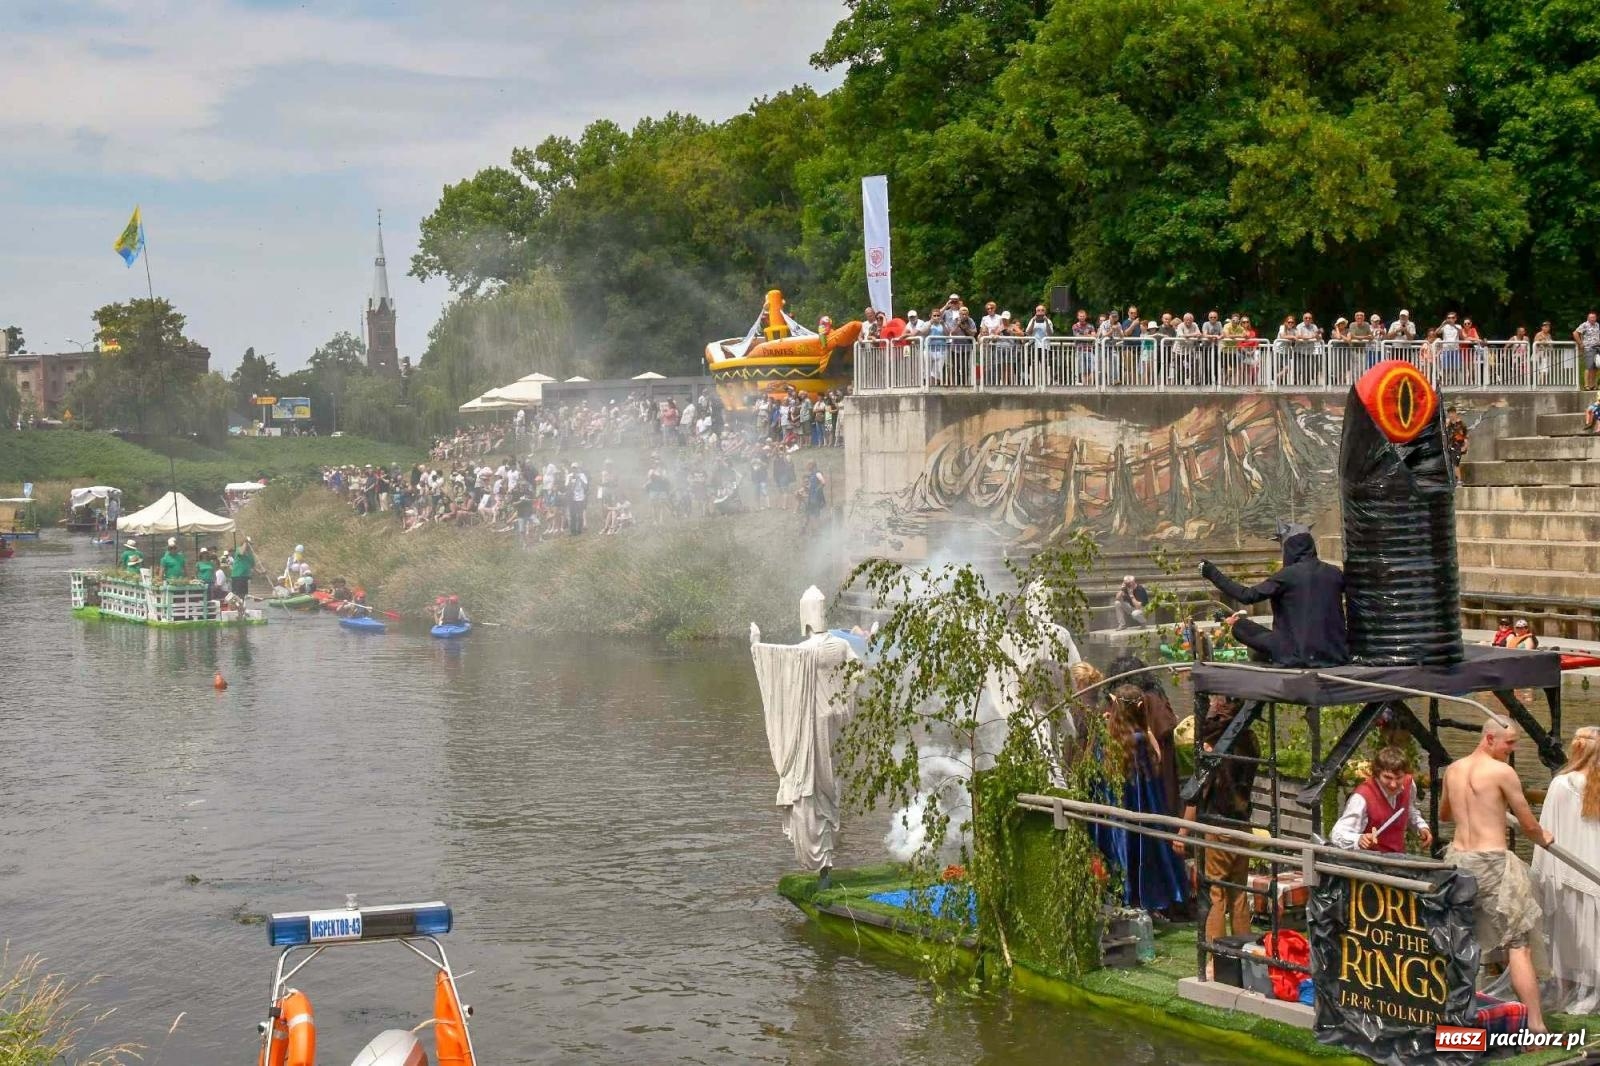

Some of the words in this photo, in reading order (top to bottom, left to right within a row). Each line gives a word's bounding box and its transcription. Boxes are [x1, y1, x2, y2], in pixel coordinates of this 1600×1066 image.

[311, 917, 361, 937] INSPEKTOR-43
[1371, 928, 1393, 946] OF
[1396, 933, 1430, 955] THE
[1338, 934, 1448, 1005] RINGS
